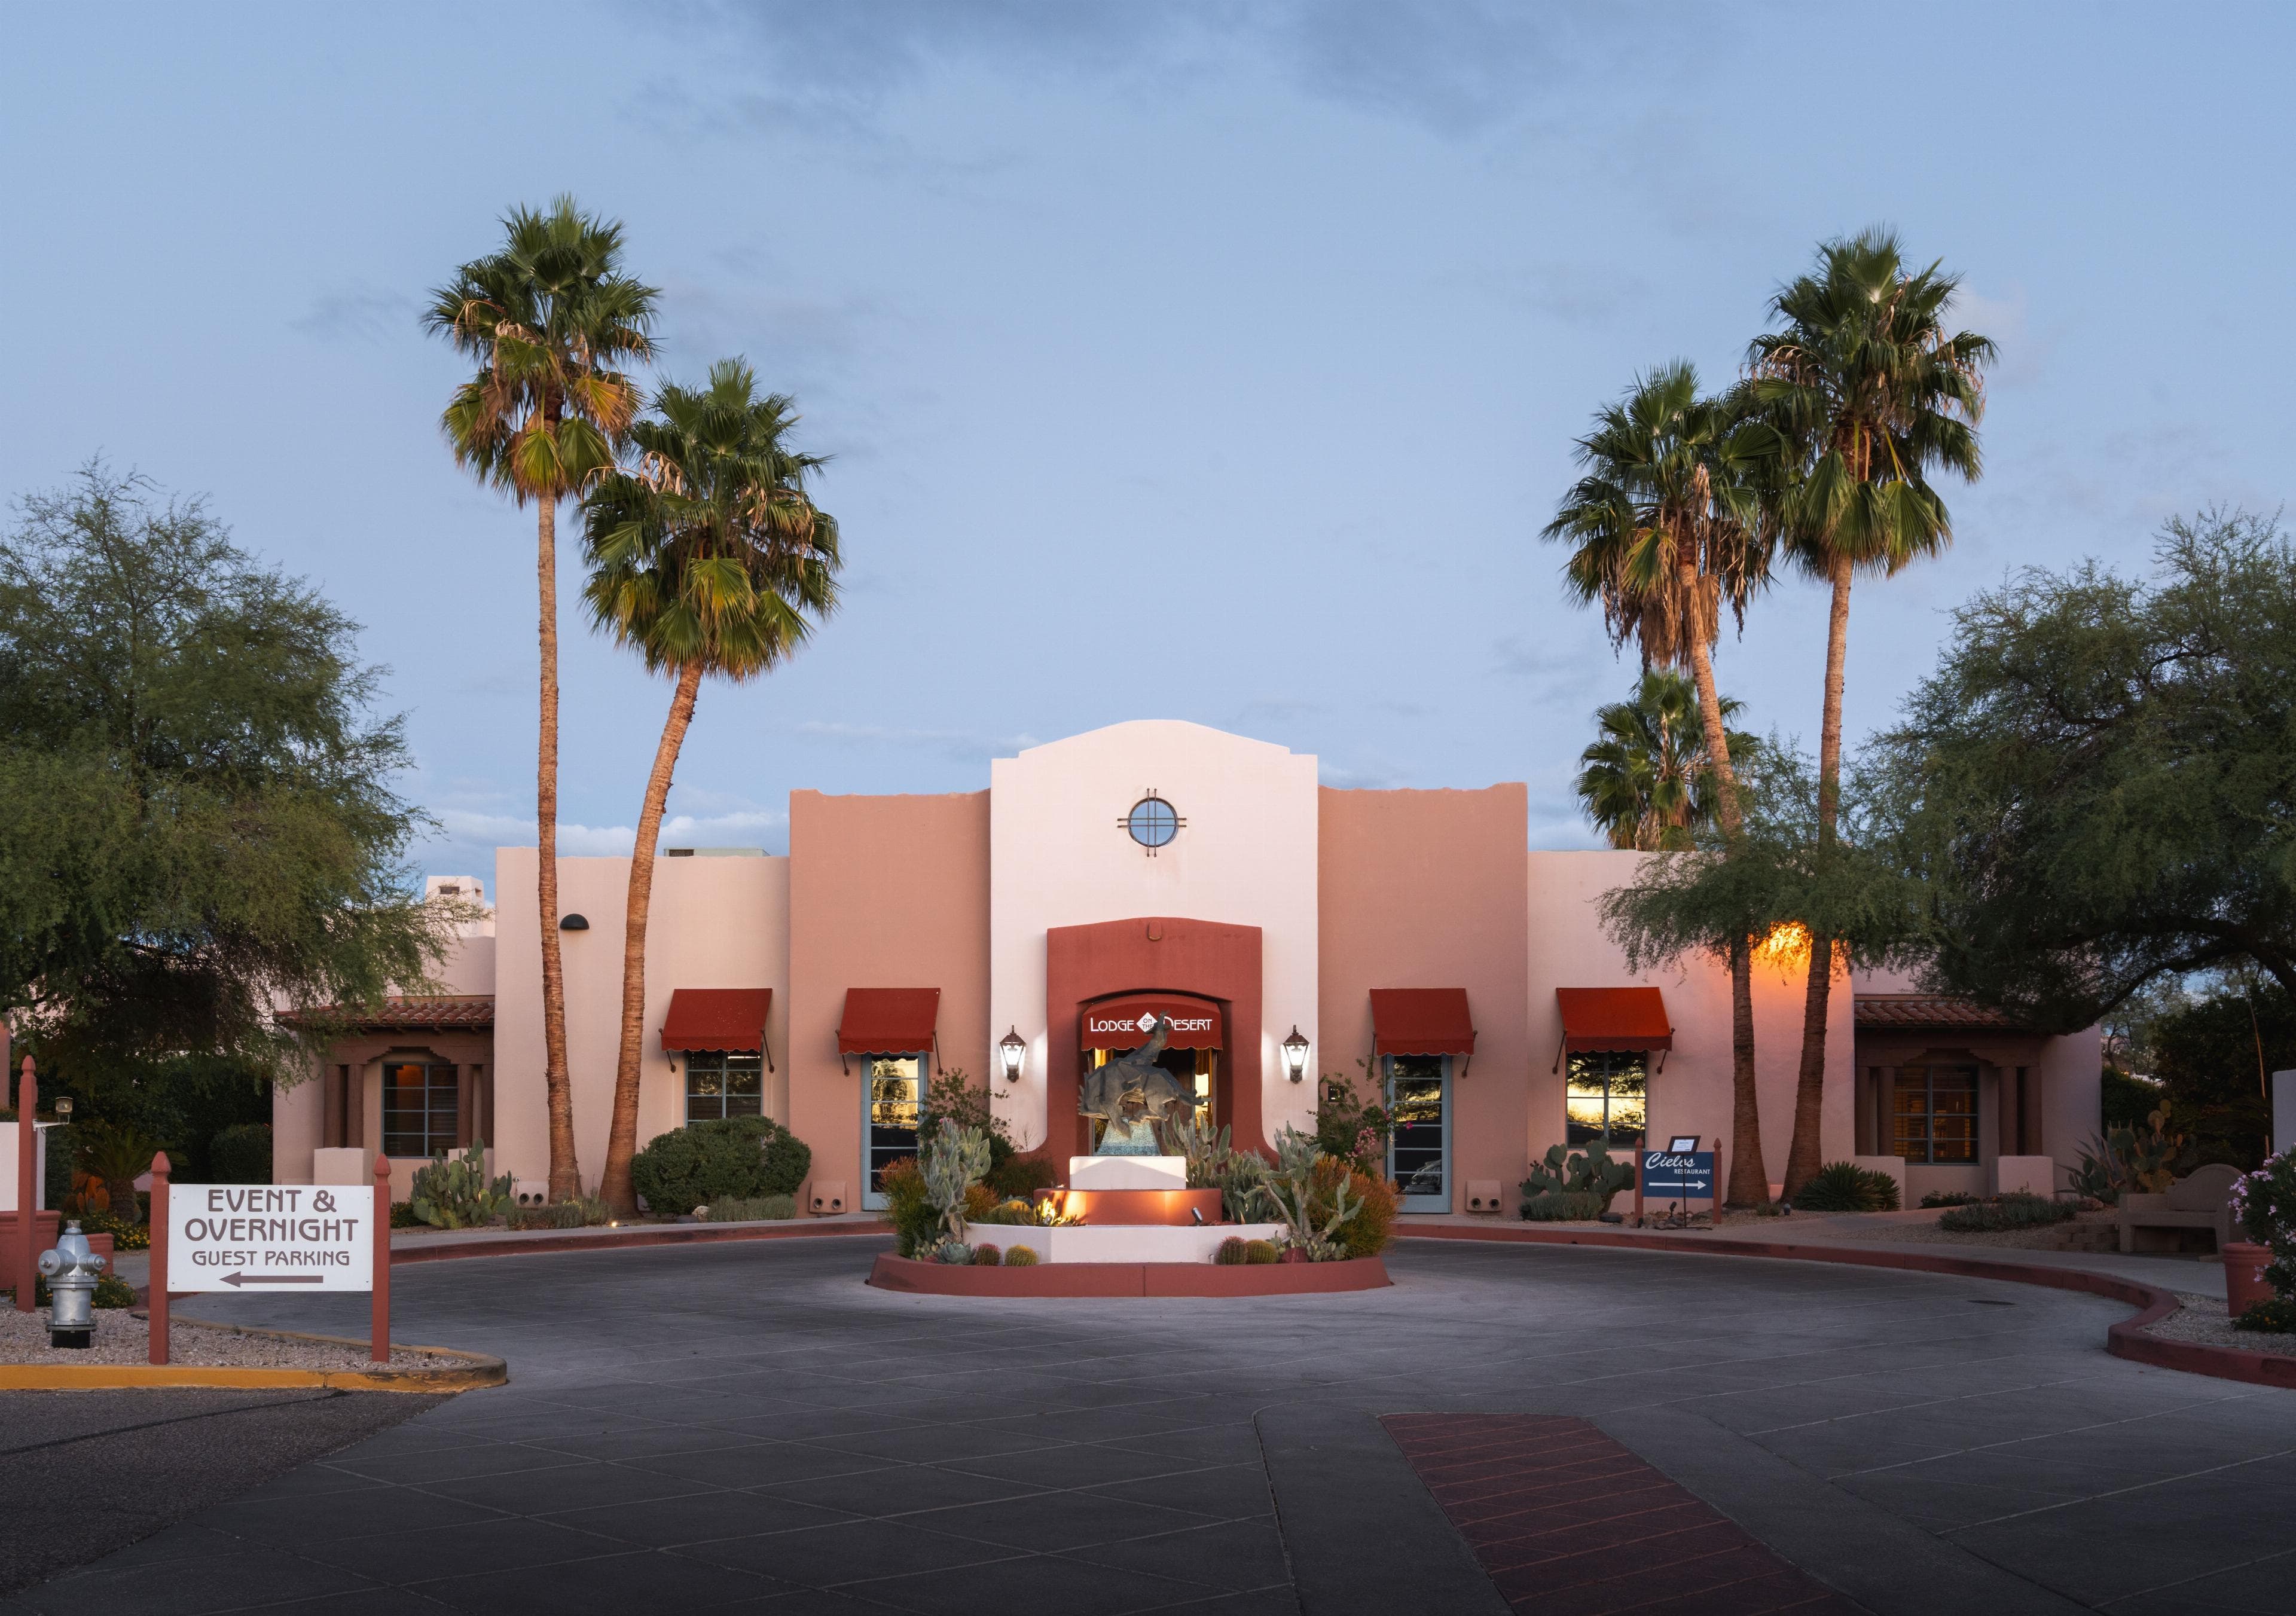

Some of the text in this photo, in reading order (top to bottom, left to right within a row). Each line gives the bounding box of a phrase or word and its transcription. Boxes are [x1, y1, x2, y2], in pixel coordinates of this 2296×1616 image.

[1090, 1017, 1134, 1032] LODGE
[1163, 1016, 1213, 1031] DESERT
[208, 1189, 337, 1213] EVENT &
[185, 1218, 359, 1242] OVERNIGHT
[192, 1251, 350, 1266] GUEST PARKING
